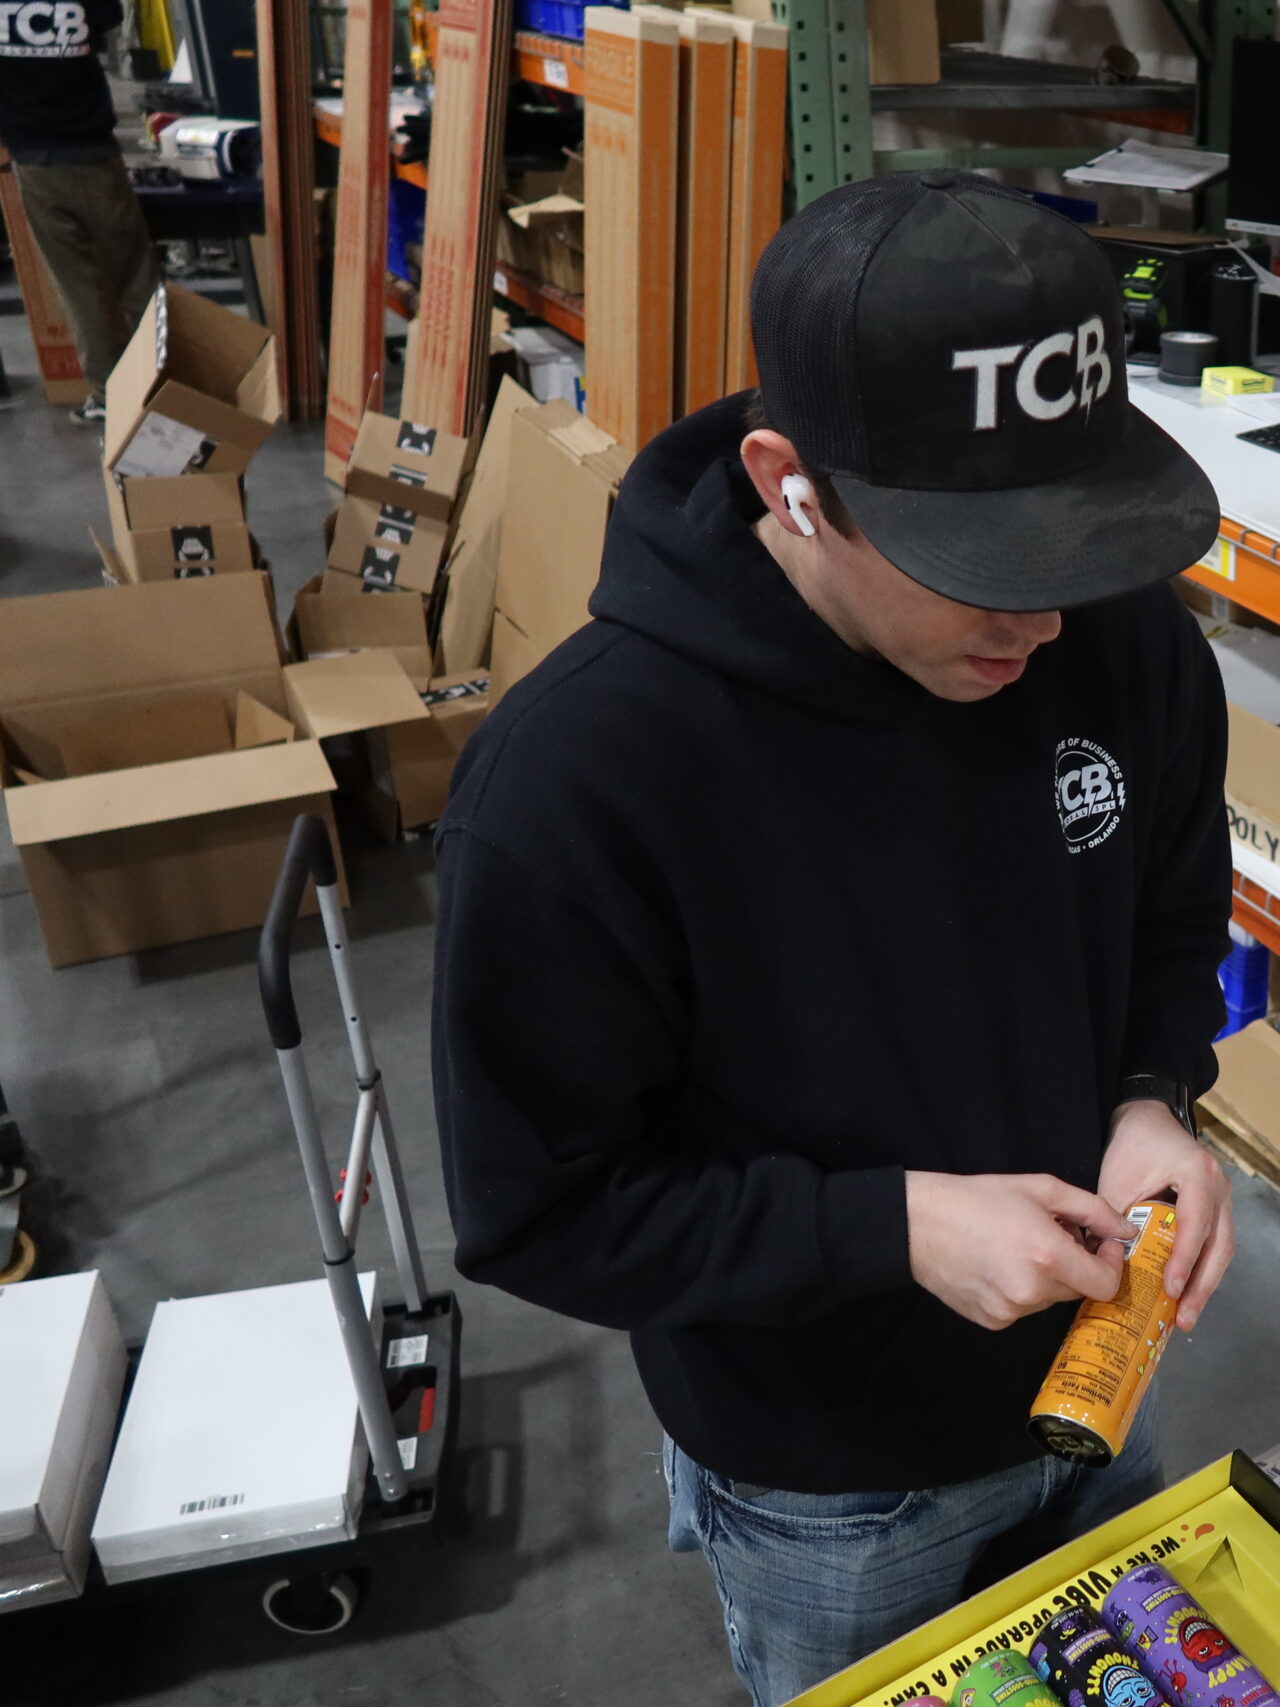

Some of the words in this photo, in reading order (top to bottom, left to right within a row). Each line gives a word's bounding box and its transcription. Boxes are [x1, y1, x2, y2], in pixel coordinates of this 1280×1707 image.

[0, 1, 89, 52] TCB
[952, 317, 1112, 430] TCB
[1081, 739, 1124, 780] BUSINESS
[1058, 763, 1112, 813] CB
[1088, 815, 1120, 849] ORLANDO
[1060, 1381, 1079, 1390] Facts
[1080, 1384, 1111, 1405] Nutrition
[1052, 1570, 1112, 1611] VIBE
[974, 1608, 1053, 1658] UPGRADE
[931, 1669, 947, 1687] A
[949, 1654, 973, 1677] IN
[1086, 1651, 1141, 1696] THOUGHTS
